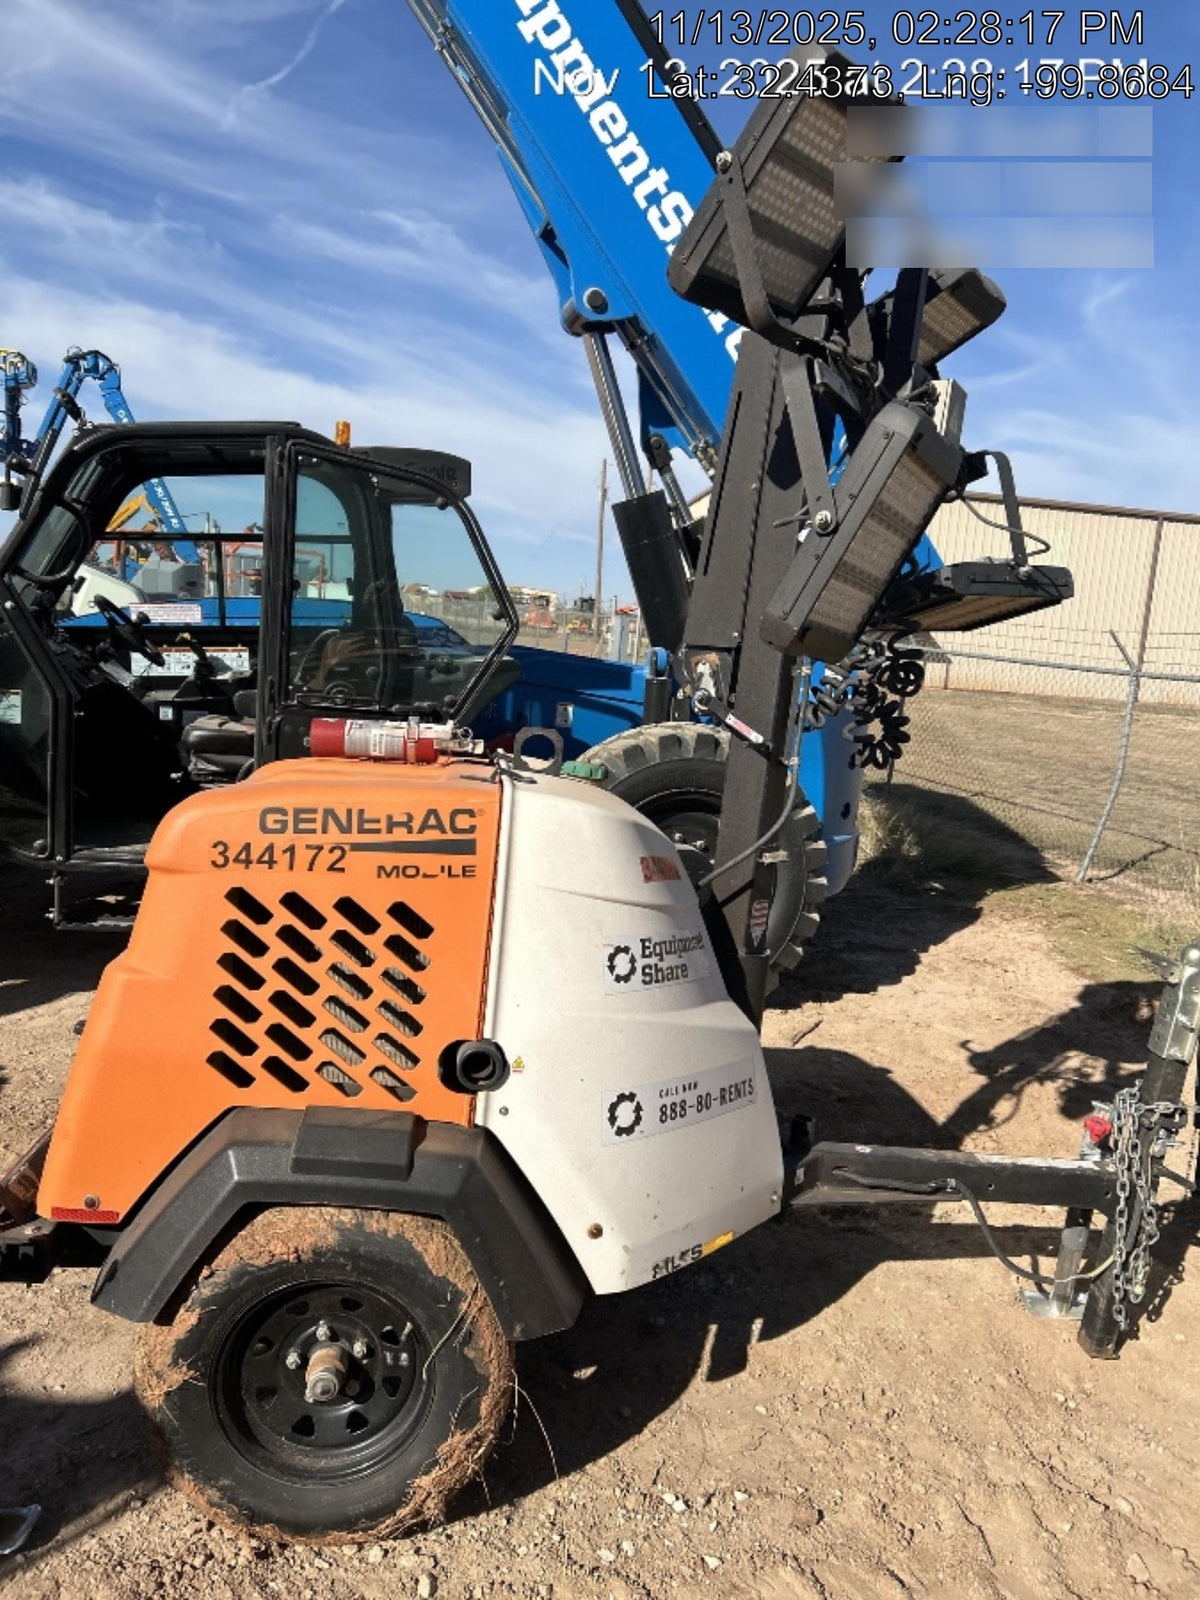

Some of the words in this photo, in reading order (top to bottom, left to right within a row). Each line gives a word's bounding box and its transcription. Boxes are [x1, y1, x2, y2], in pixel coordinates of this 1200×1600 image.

[258, 807, 477, 835] GENERAC
[210, 840, 348, 874] 344172
[640, 962, 689, 986] Share
[659, 1077, 755, 1124] 888-80-RENTS
